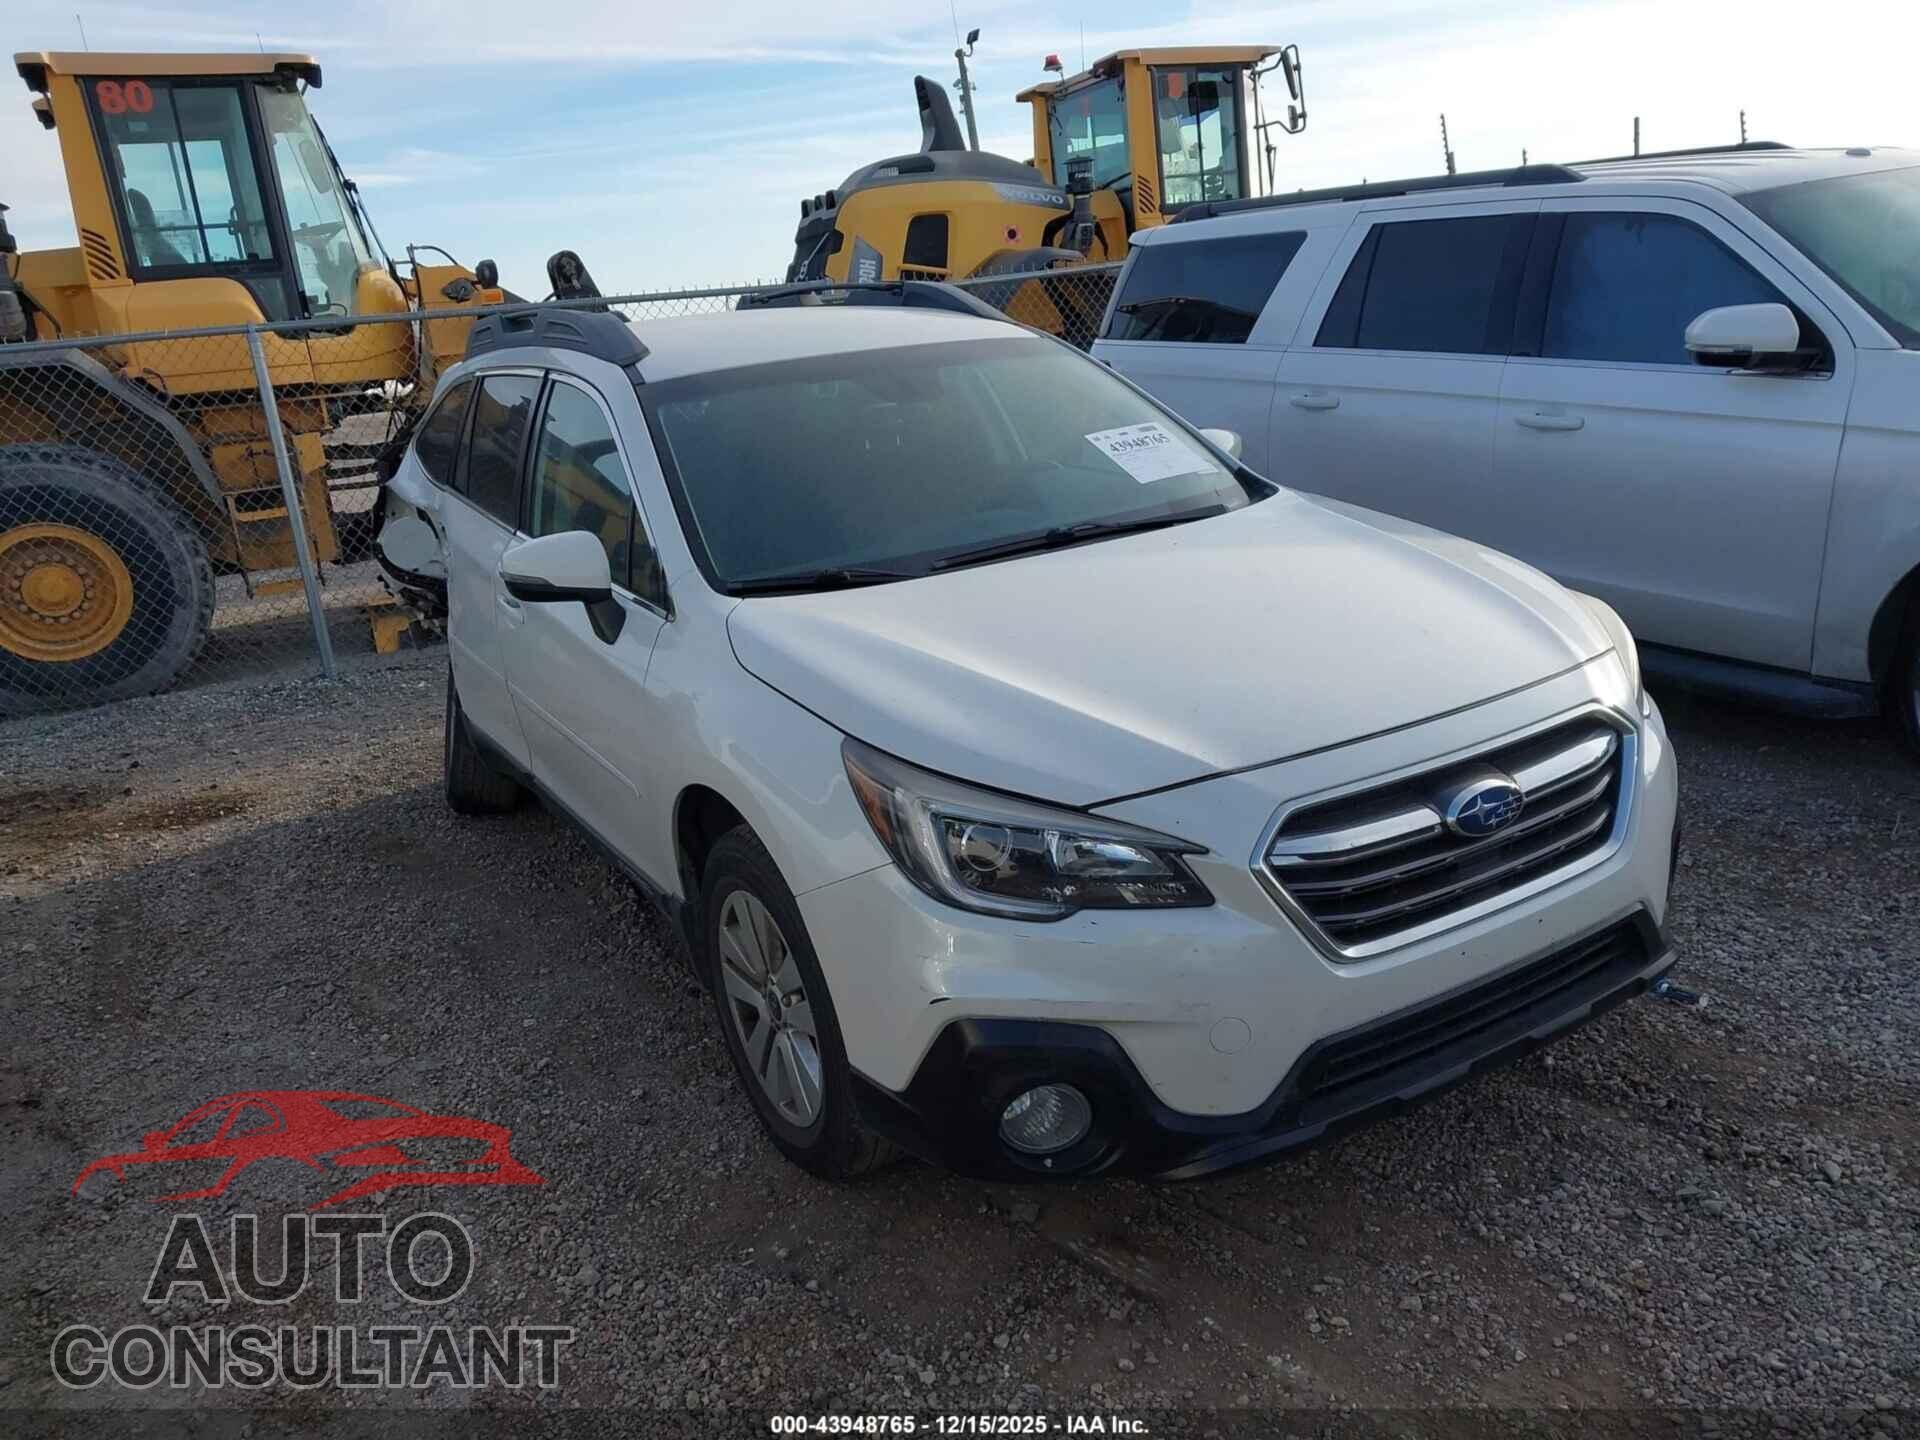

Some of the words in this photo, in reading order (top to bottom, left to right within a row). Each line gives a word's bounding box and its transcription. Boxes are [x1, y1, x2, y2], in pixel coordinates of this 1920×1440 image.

[96, 80, 152, 112] 80
[1000, 188, 1064, 204] VOLVO
[1110, 433, 1170, 452] 43948765
